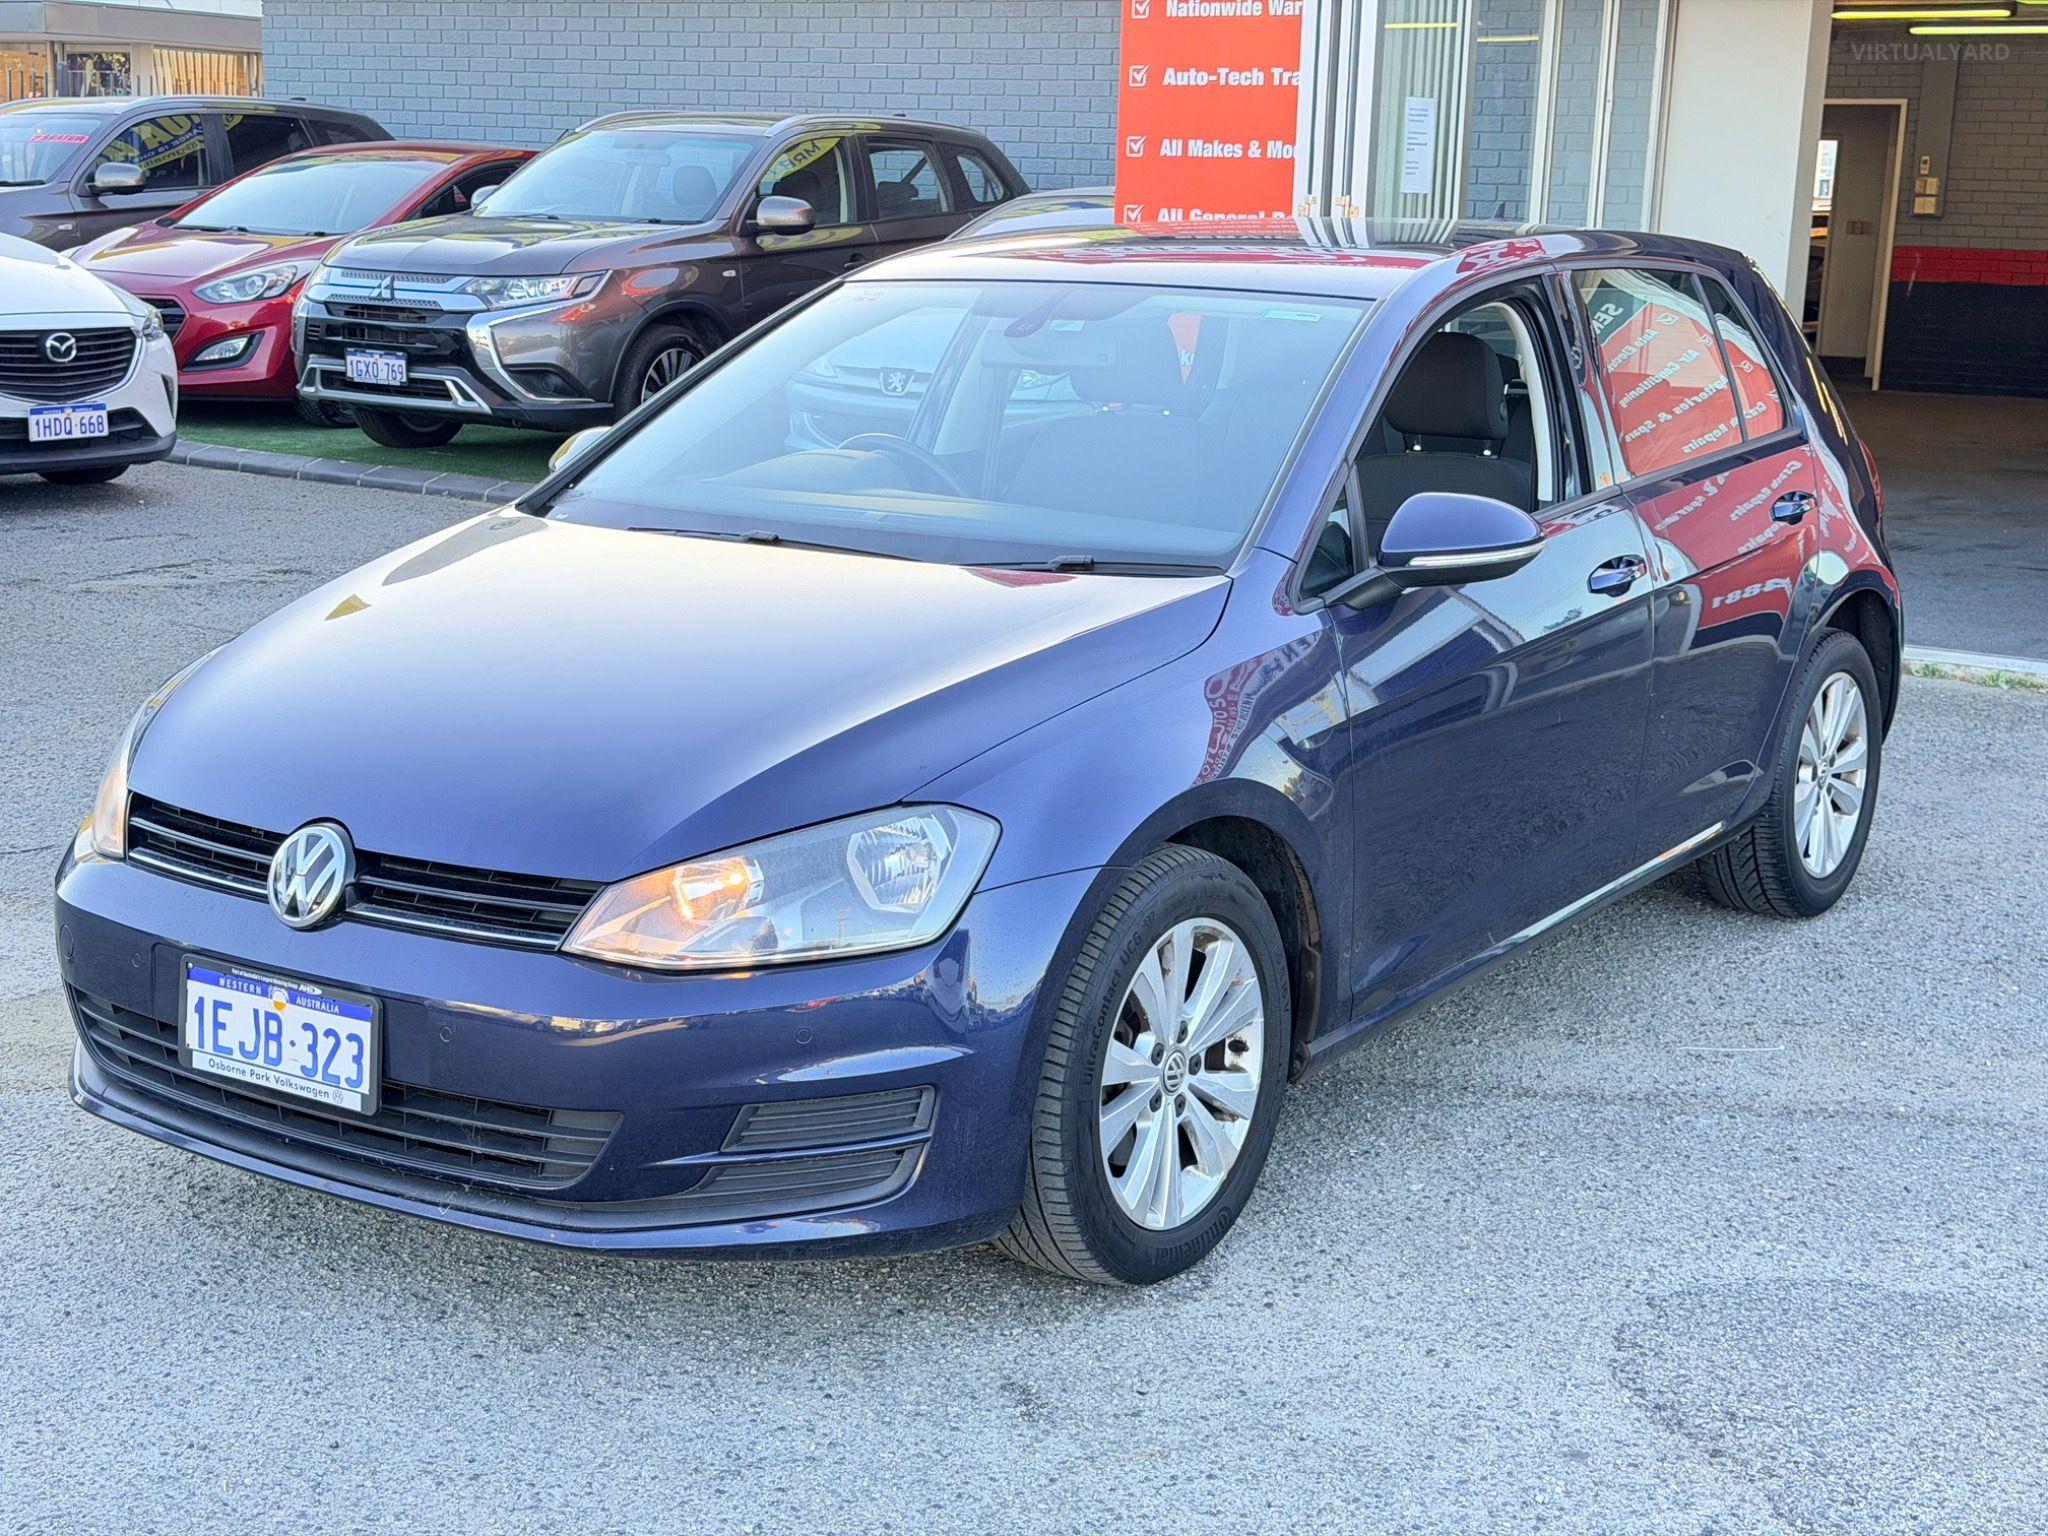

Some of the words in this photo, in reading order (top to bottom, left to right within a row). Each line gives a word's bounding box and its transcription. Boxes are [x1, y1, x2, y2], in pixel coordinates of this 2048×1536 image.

[1166, 0, 1263, 17] Nationwide
[1162, 67, 1265, 86] Auto-Tech
[1160, 139, 1183, 157] All
[1187, 139, 1243, 158] Makes
[1247, 140, 1262, 158] &
[1266, 140, 1296, 159] Mo
[1157, 208, 1183, 222] All
[219, 977, 263, 996] WESTERN
[296, 996, 340, 1015] AUSTRALIA
[208, 1058, 247, 1078] Osborne
[250, 1069, 271, 1084] Park
[274, 1076, 330, 1100] Volkswagen
